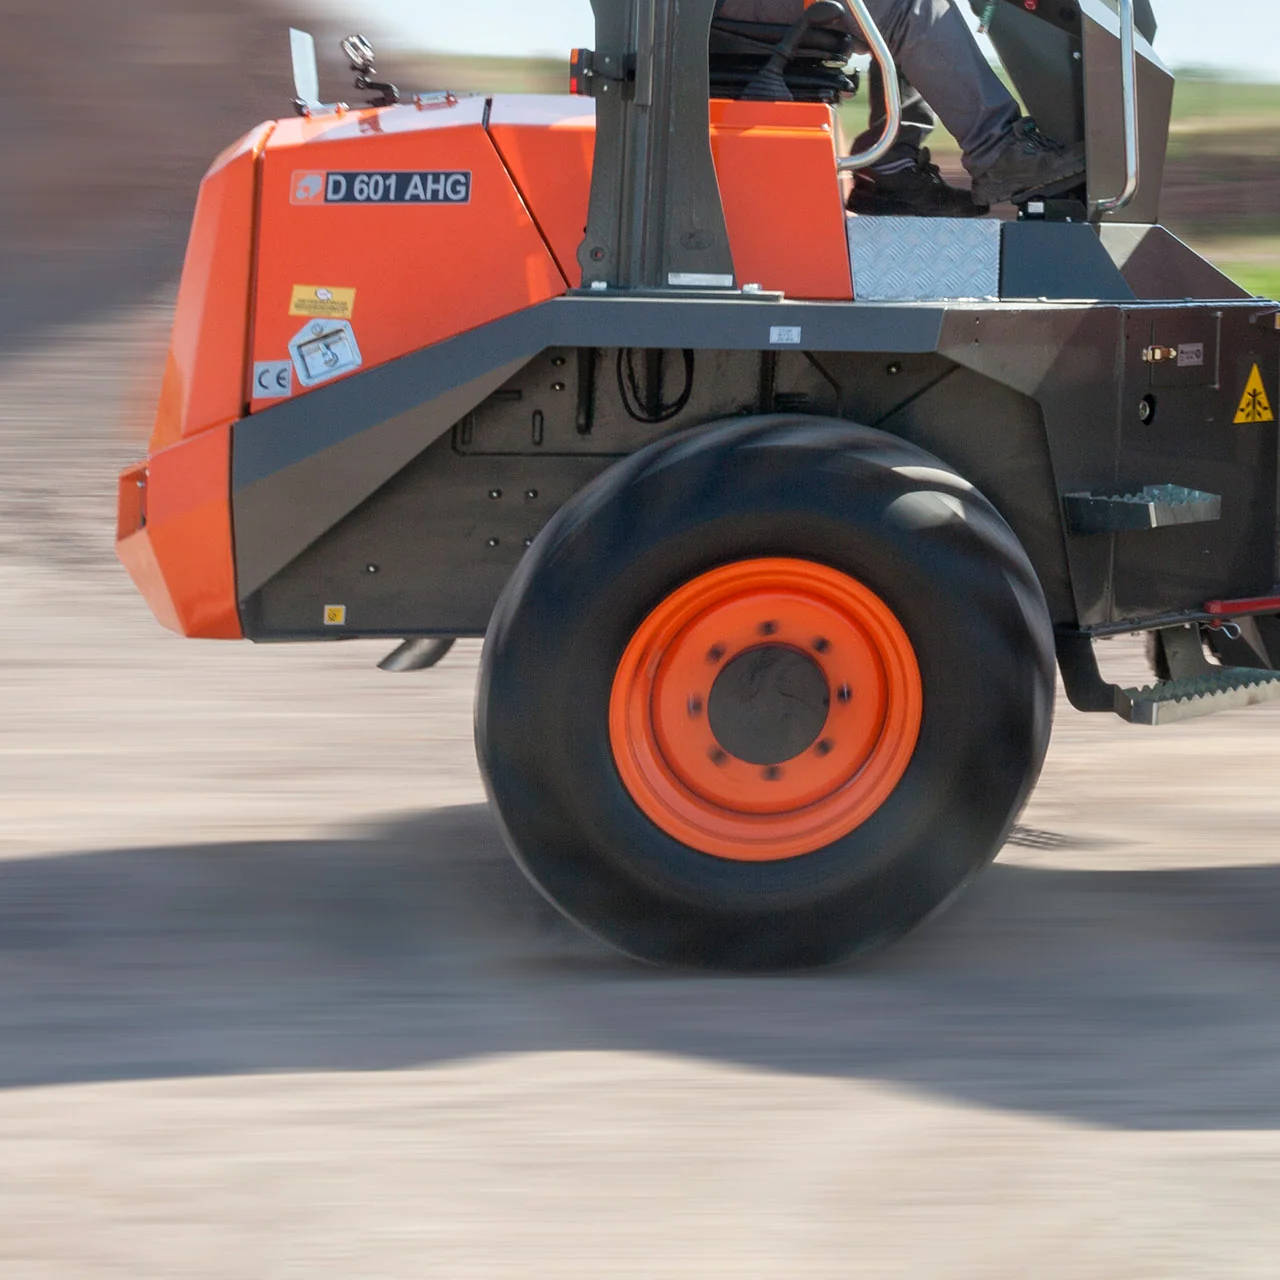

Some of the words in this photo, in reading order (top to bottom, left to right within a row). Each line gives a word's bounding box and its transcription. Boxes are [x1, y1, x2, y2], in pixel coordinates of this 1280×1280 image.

[327, 175, 347, 200] D
[353, 174, 397, 201] 601
[404, 174, 467, 201] AHG
[258, 368, 287, 389] CE
